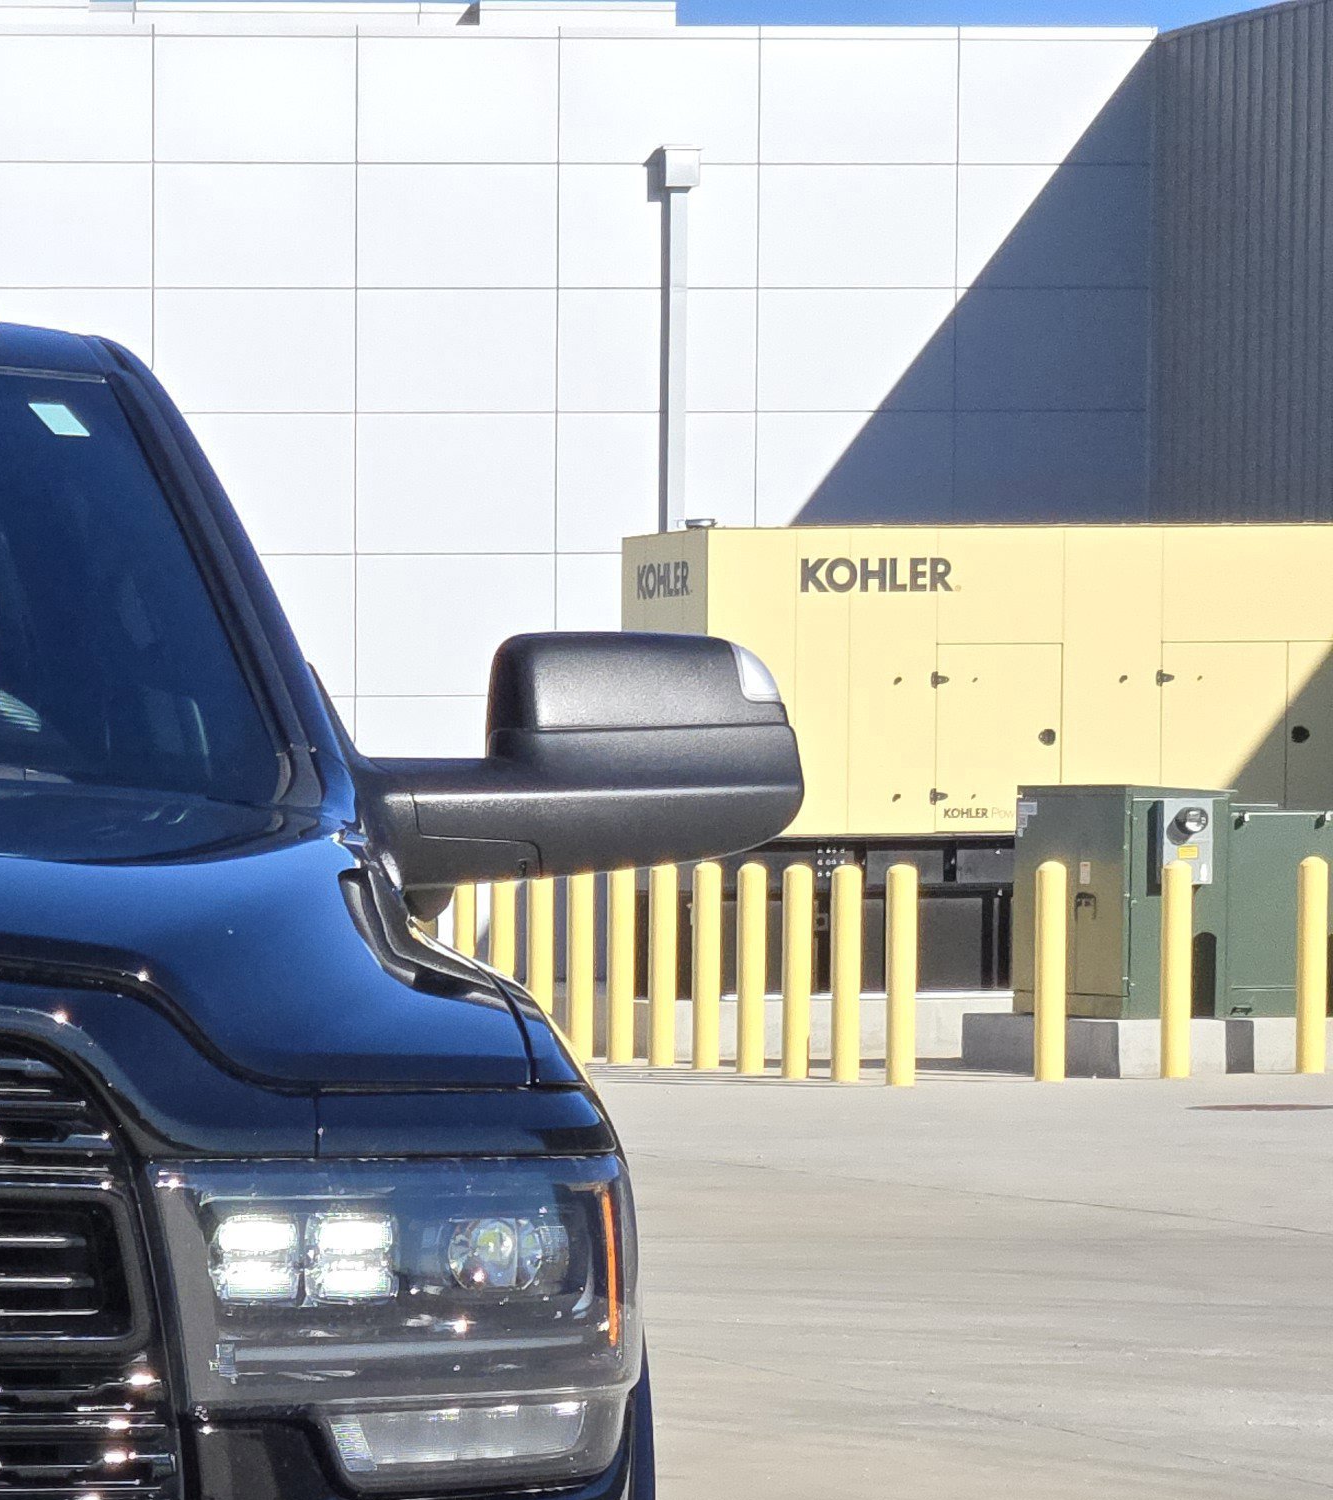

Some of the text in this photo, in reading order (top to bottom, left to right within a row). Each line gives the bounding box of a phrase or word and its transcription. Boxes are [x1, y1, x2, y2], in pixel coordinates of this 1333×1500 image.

[637, 560, 691, 600] KOHLER
[799, 556, 955, 594] KOHLER
[943, 807, 989, 819] KOHLER
